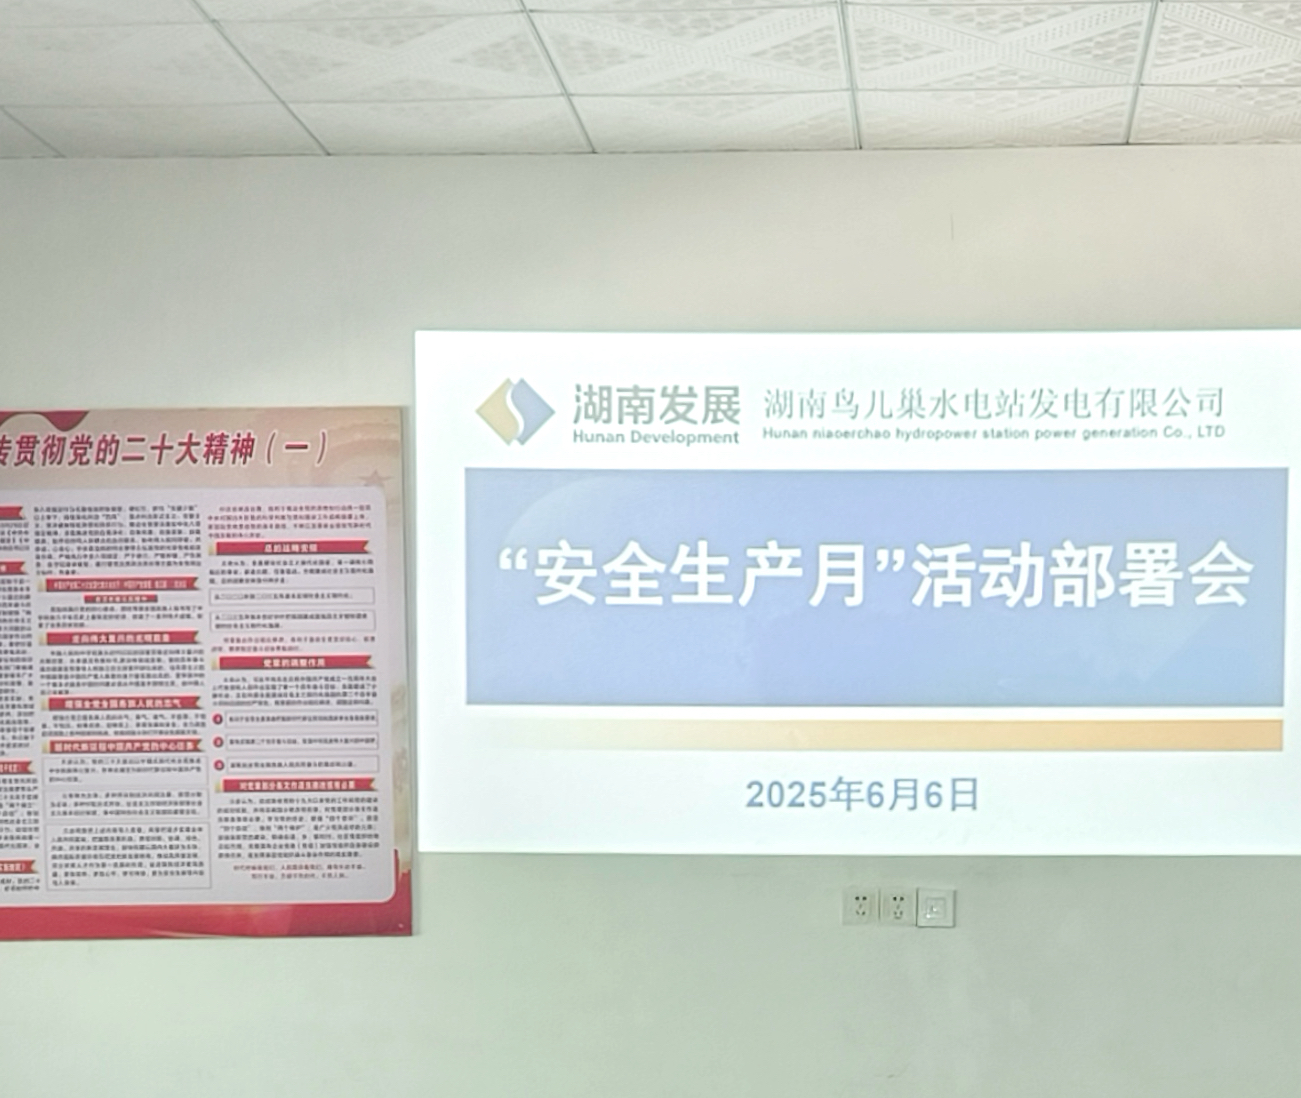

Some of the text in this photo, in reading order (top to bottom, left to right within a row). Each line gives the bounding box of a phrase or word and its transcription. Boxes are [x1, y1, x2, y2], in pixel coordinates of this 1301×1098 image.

[573, 383, 741, 425] 湖南发展
[763, 386, 1224, 421] 湖南鸟儿巢水电站发电有限公司
[573, 430, 740, 447] Hunan Development
[763, 427, 808, 440] Hunan
[895, 427, 977, 442] hydropower
[982, 426, 1029, 440] station
[1035, 427, 1077, 442] power
[1082, 426, 1158, 442] generation
[1197, 425, 1225, 439] LTD
[497, 538, 1255, 609] “安全生产月”活动部署会
[745, 776, 979, 814] 2025年6月6日
